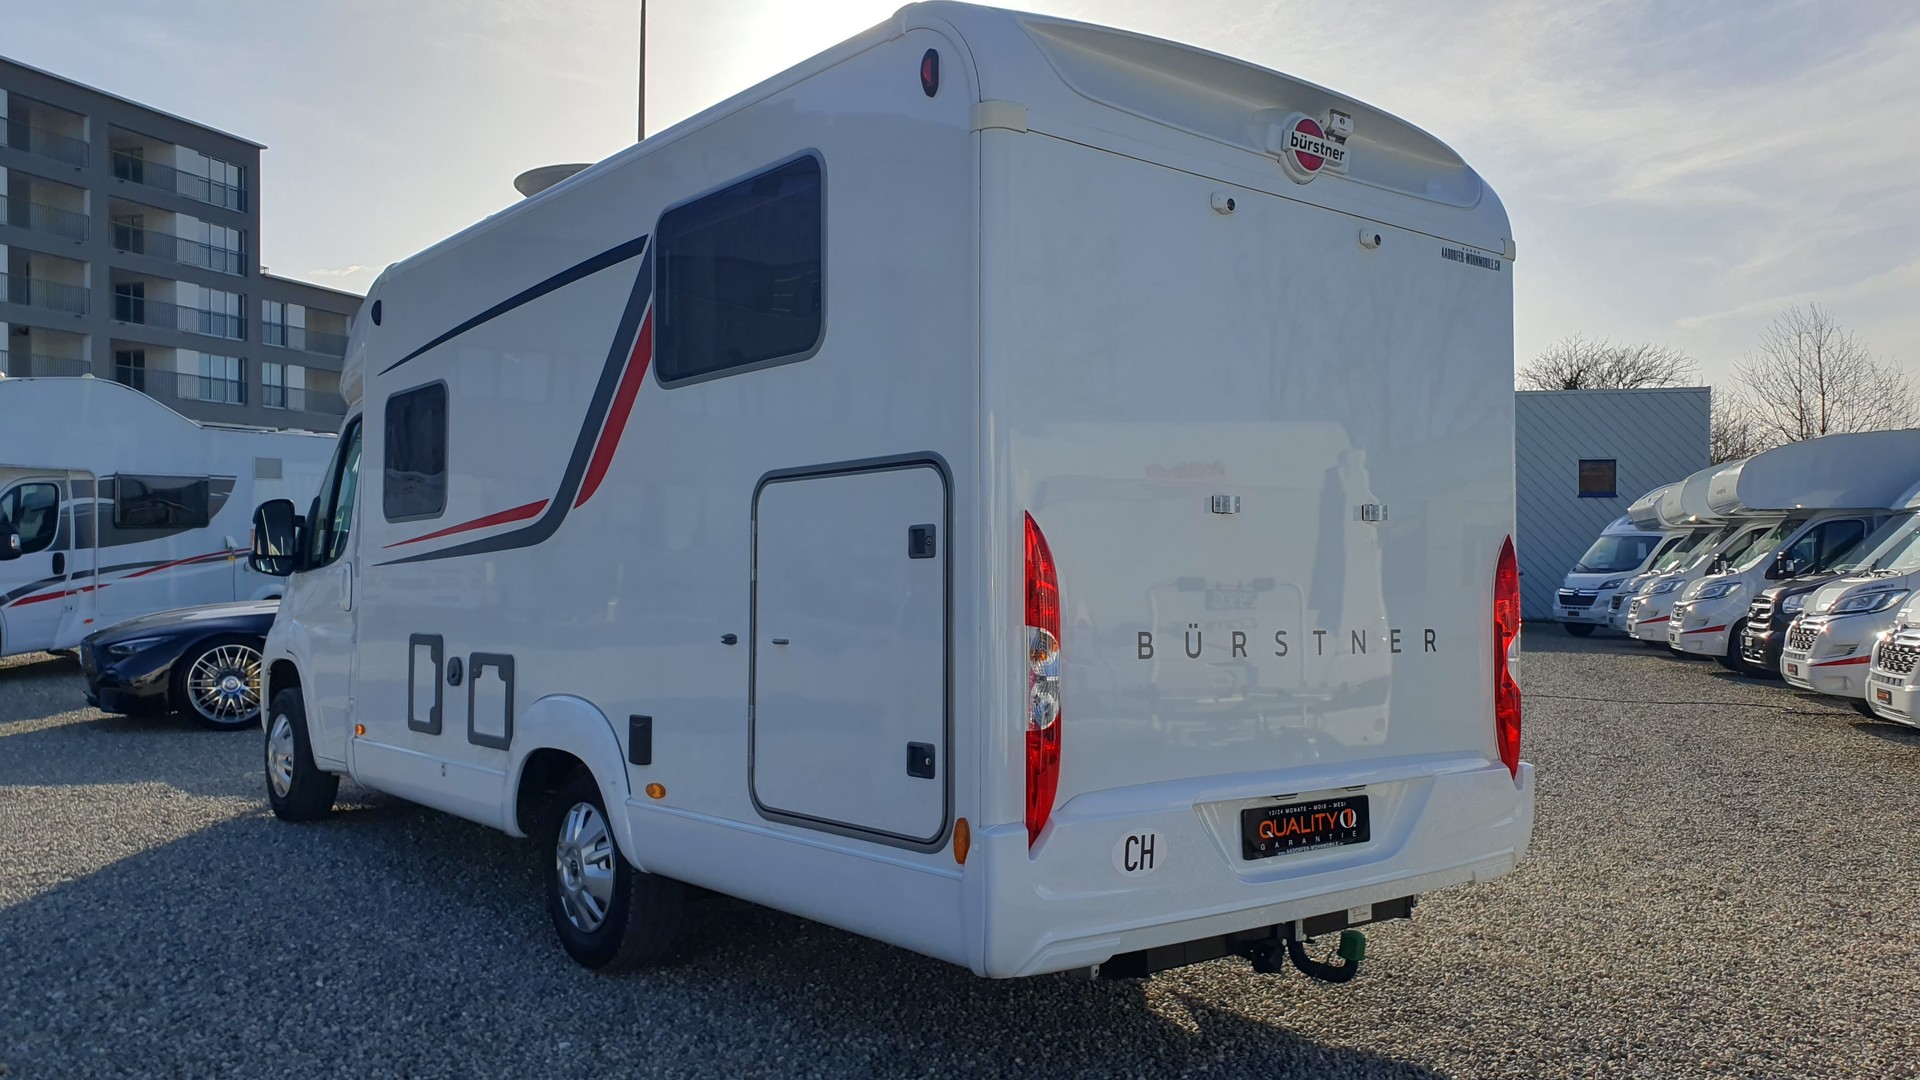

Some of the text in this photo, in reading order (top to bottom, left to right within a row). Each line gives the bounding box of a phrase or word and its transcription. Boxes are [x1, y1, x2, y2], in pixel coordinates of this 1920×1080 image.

[1290, 131, 1345, 161] bürstner
[1137, 623, 1437, 660] BÜRSTNER
[1285, 806, 1307, 814] MONATE
[1313, 803, 1327, 811] MOIS
[1259, 811, 1338, 839] QUALITY
[1124, 834, 1155, 872] CH
[1260, 830, 1357, 851] GARANTIE
